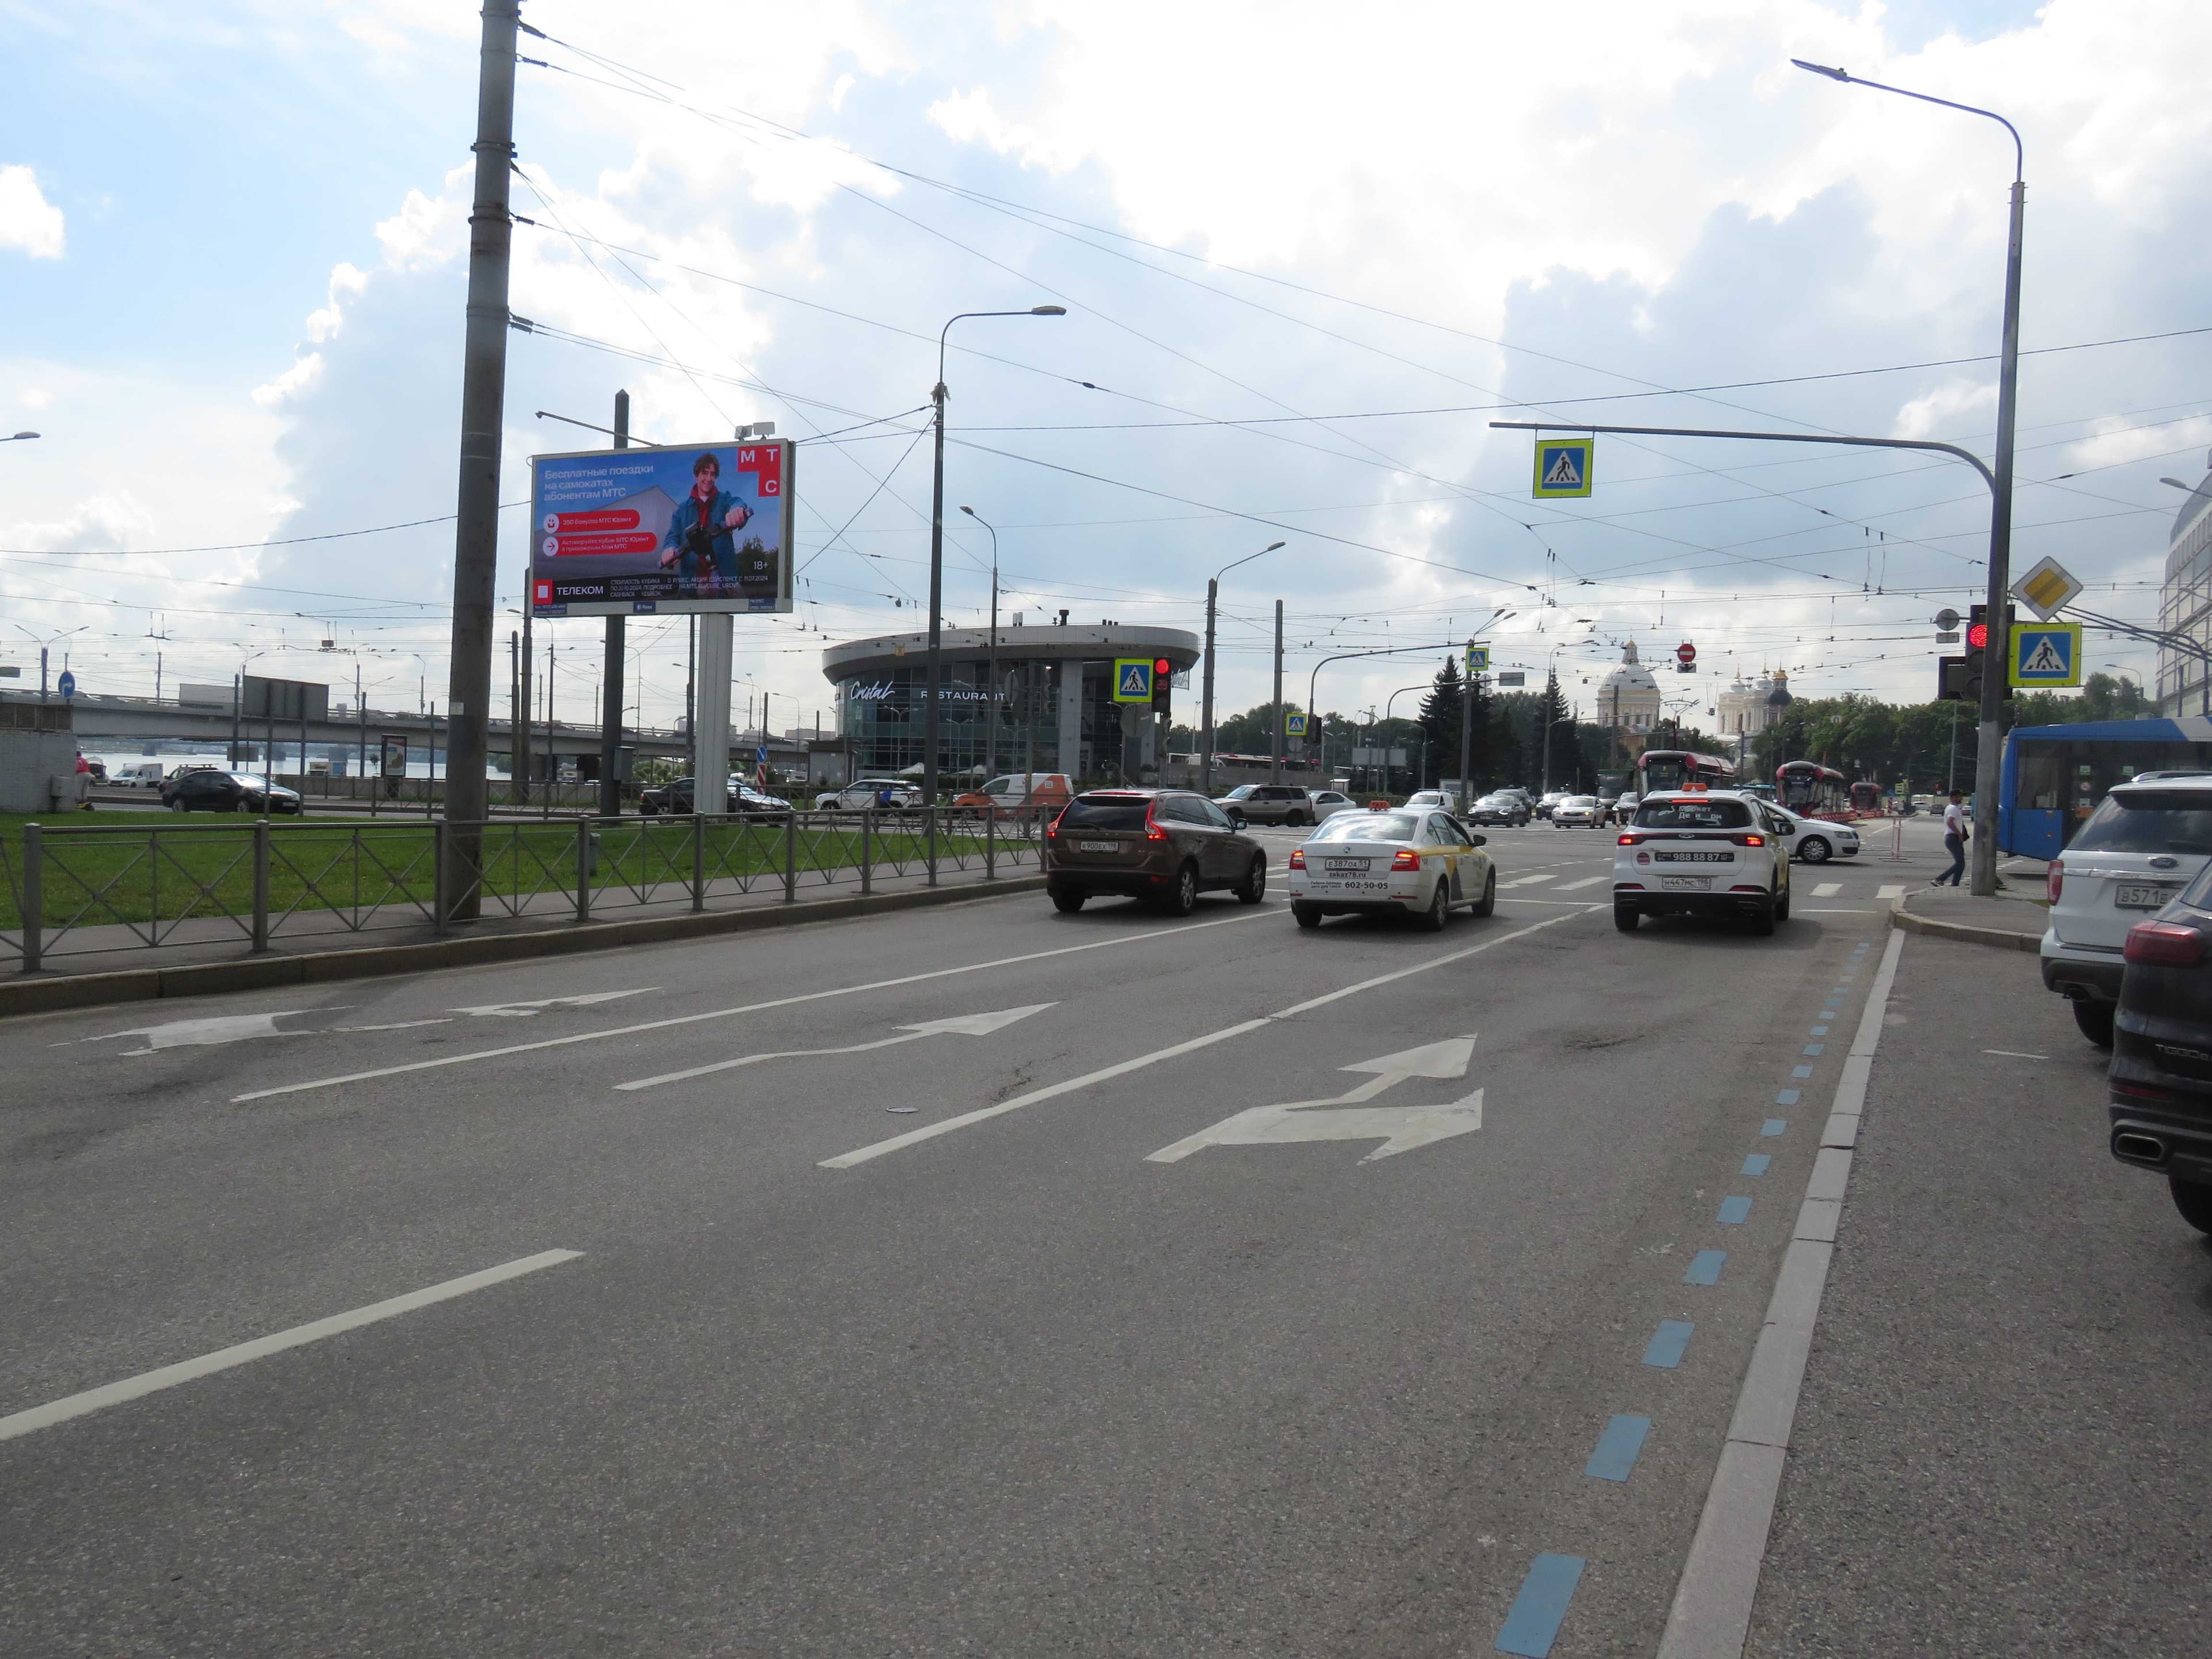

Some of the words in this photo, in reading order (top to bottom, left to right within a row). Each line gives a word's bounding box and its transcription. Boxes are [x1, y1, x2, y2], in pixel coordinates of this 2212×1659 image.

[545, 468, 608, 479] Бесплатные
[609, 465, 654, 476] поездки
[559, 479, 613, 489] самокатах
[544, 490, 600, 501] абонентам
[603, 488, 626, 497] МТС
[753, 560, 768, 570] 18+
[556, 586, 604, 596] ТЕЛЕКОМ
[849, 680, 895, 700] Cristal
[921, 691, 1005, 700] RSTAURAT
[1673, 853, 1691, 861] 988
[1693, 853, 1706, 861] 88
[1707, 853, 1720, 861] 87
[2122, 889, 2168, 904] В571Е
